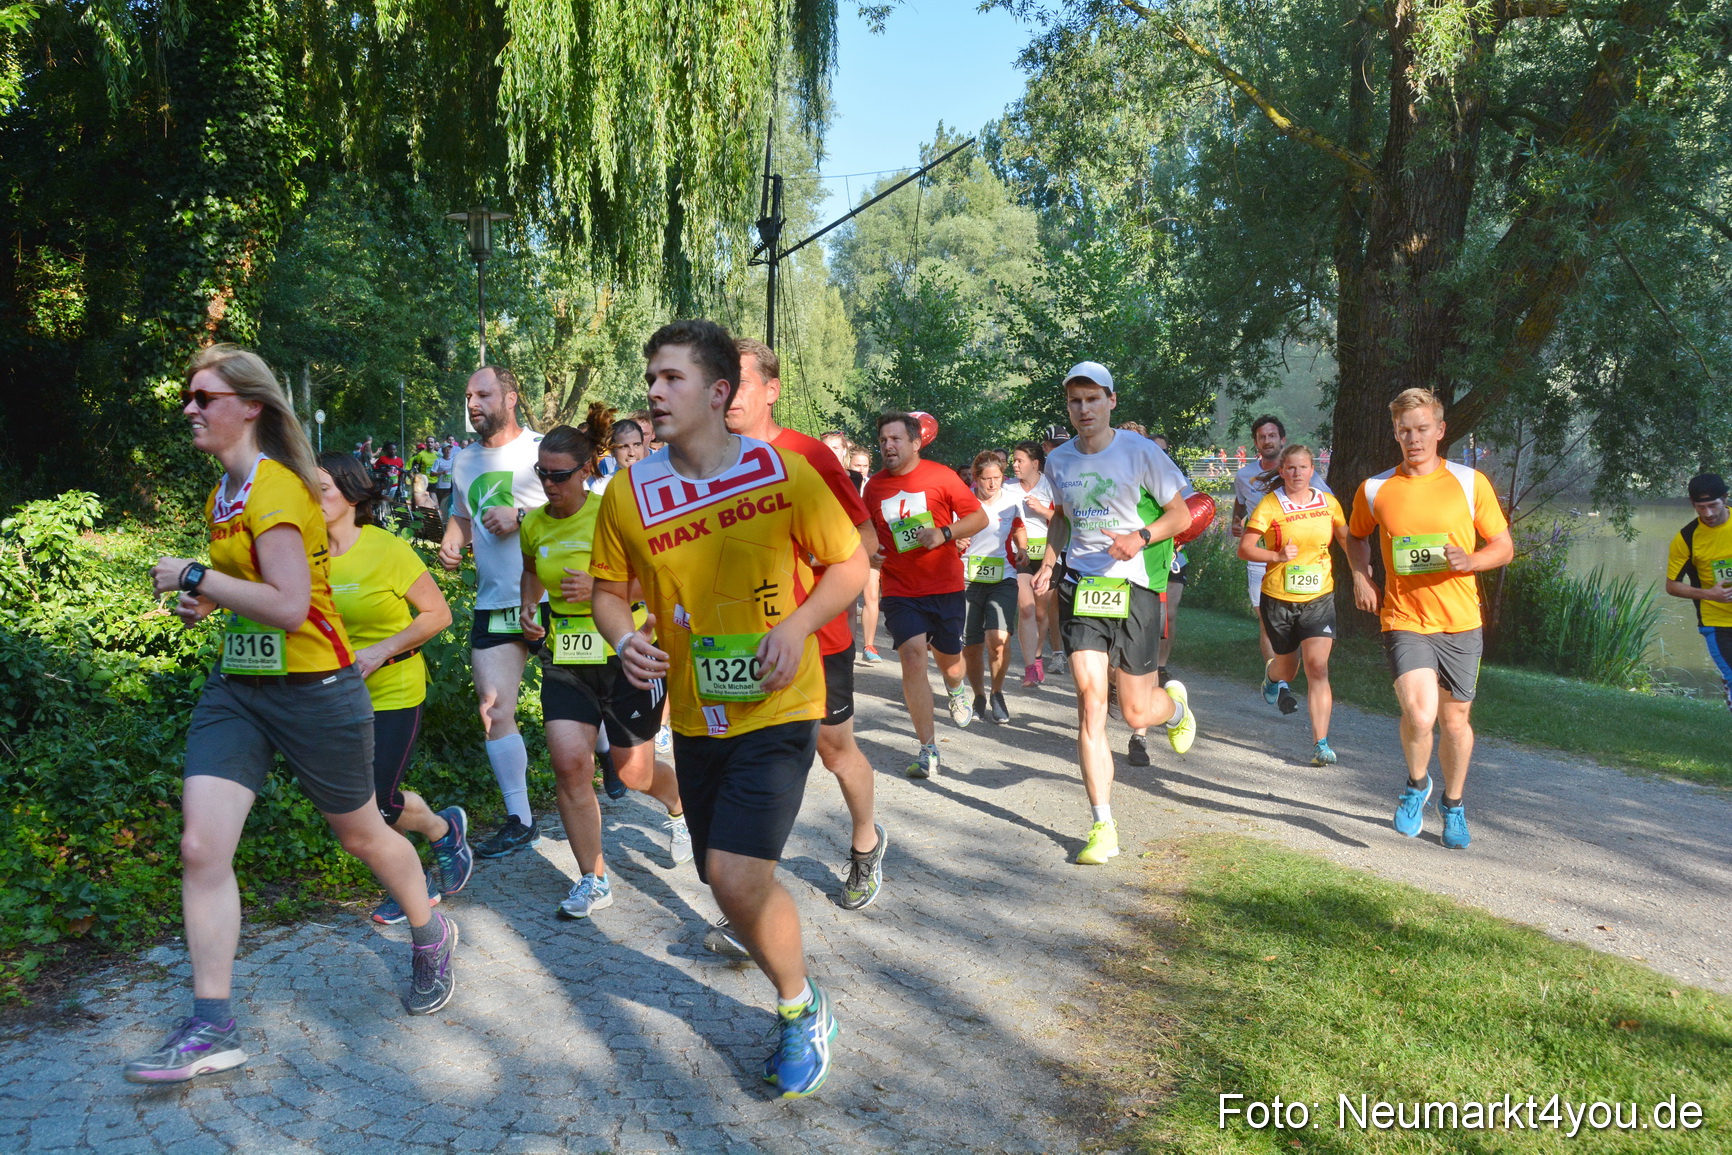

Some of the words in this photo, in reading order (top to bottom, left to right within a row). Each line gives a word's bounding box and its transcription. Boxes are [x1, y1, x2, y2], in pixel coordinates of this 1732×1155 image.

[647, 517, 712, 556] MAX
[717, 492, 792, 529] BÖGL
[1285, 512, 1308, 523] MAX
[1410, 548, 1431, 564] 99
[976, 565, 995, 576] 251
[1290, 574, 1319, 586] 1296
[1082, 590, 1122, 606] 1024
[227, 633, 275, 657] 1316
[562, 634, 593, 651] 970
[701, 658, 764, 683] 1320
[713, 682, 726, 690] Dick
[727, 682, 754, 690] Michael
